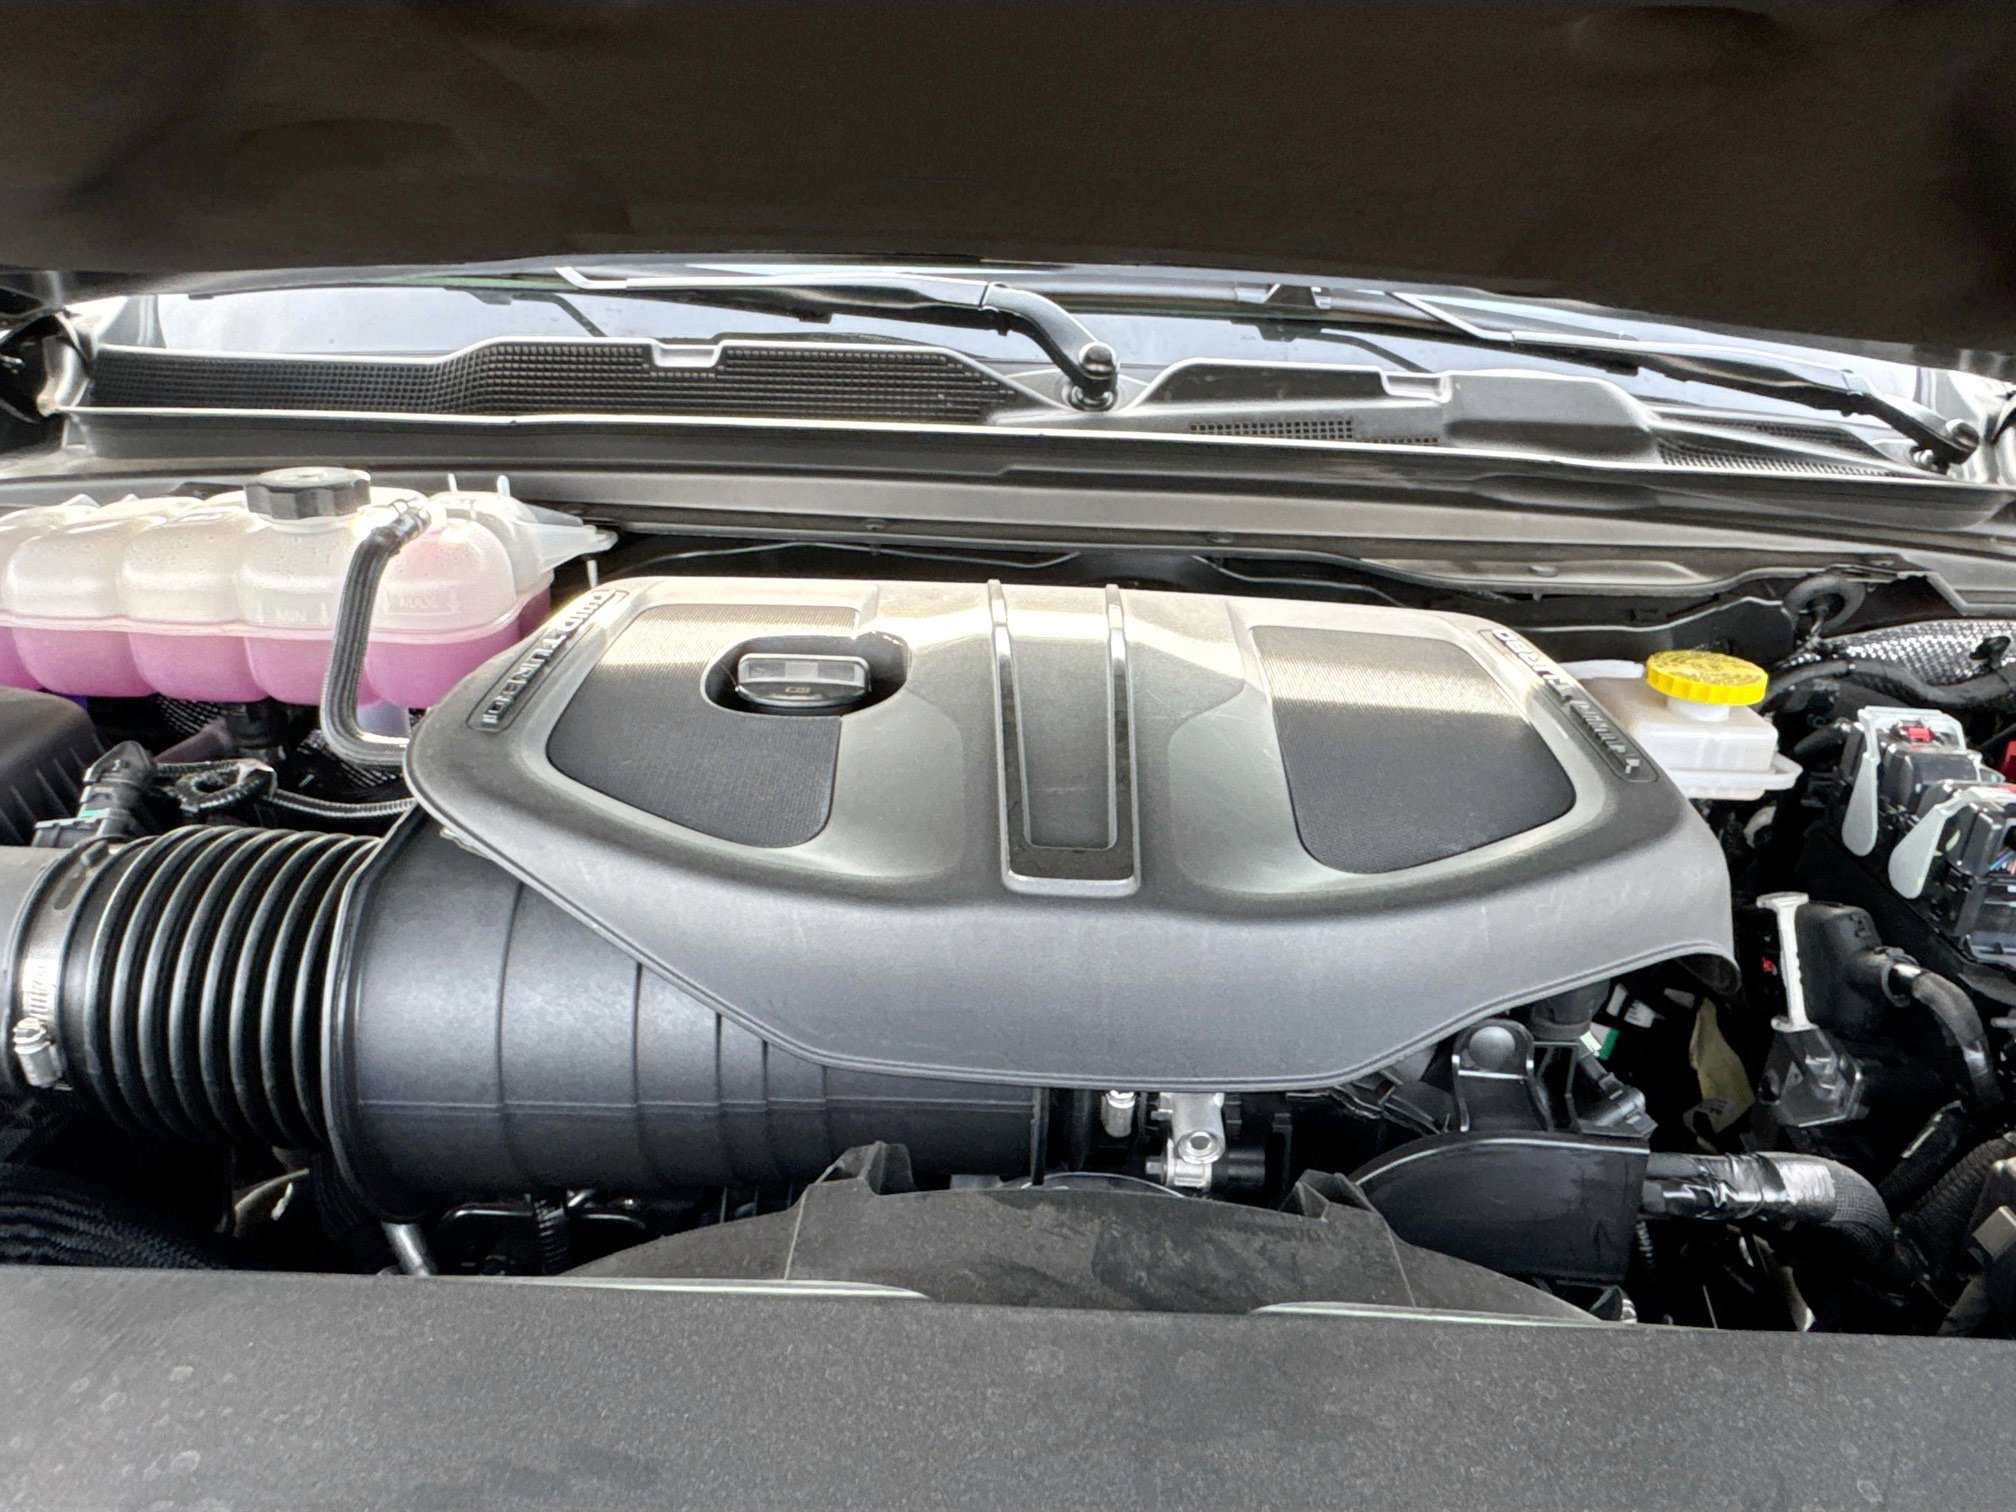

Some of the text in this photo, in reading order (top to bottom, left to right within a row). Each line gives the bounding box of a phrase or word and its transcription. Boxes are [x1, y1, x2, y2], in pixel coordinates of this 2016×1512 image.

[399, 591, 438, 608] MAX
[275, 608, 307, 622] MIN
[1492, 627, 1574, 701] TURBO
